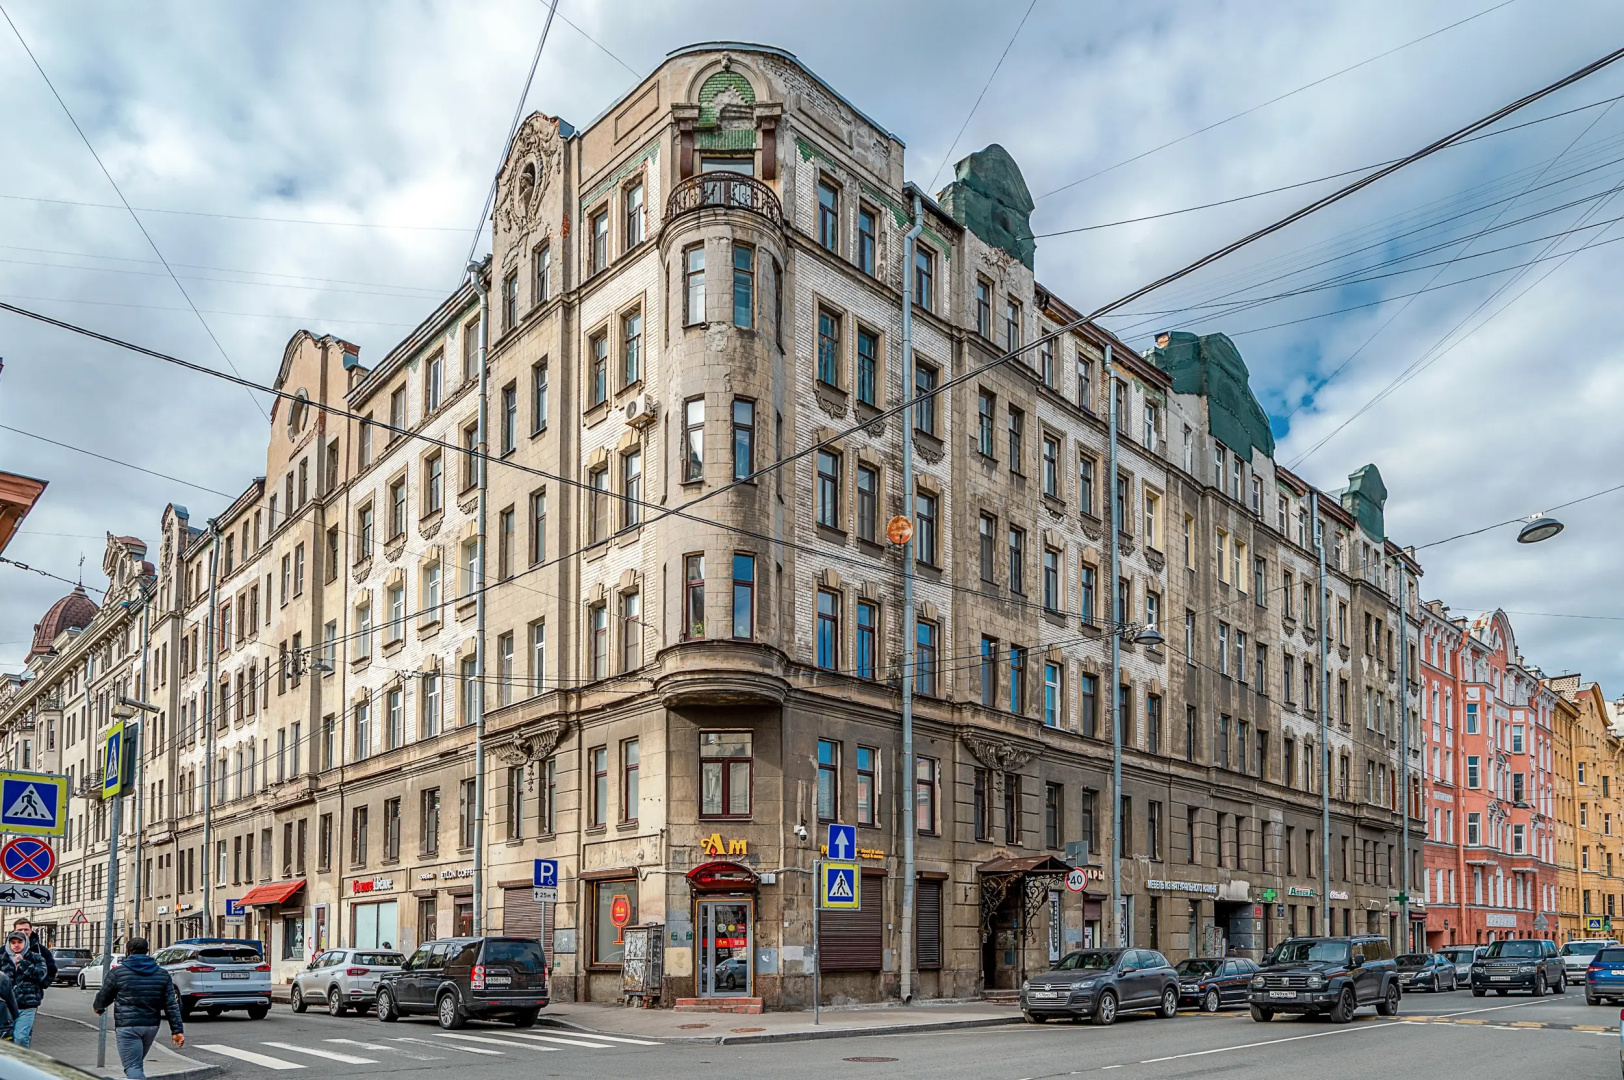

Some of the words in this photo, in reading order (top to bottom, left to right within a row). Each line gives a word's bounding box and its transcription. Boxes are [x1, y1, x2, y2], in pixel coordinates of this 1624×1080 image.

[540, 862, 554, 884] P
[1069, 875, 1083, 886] 40
[1148, 880, 1164, 890] МЕБЕЛЬ
